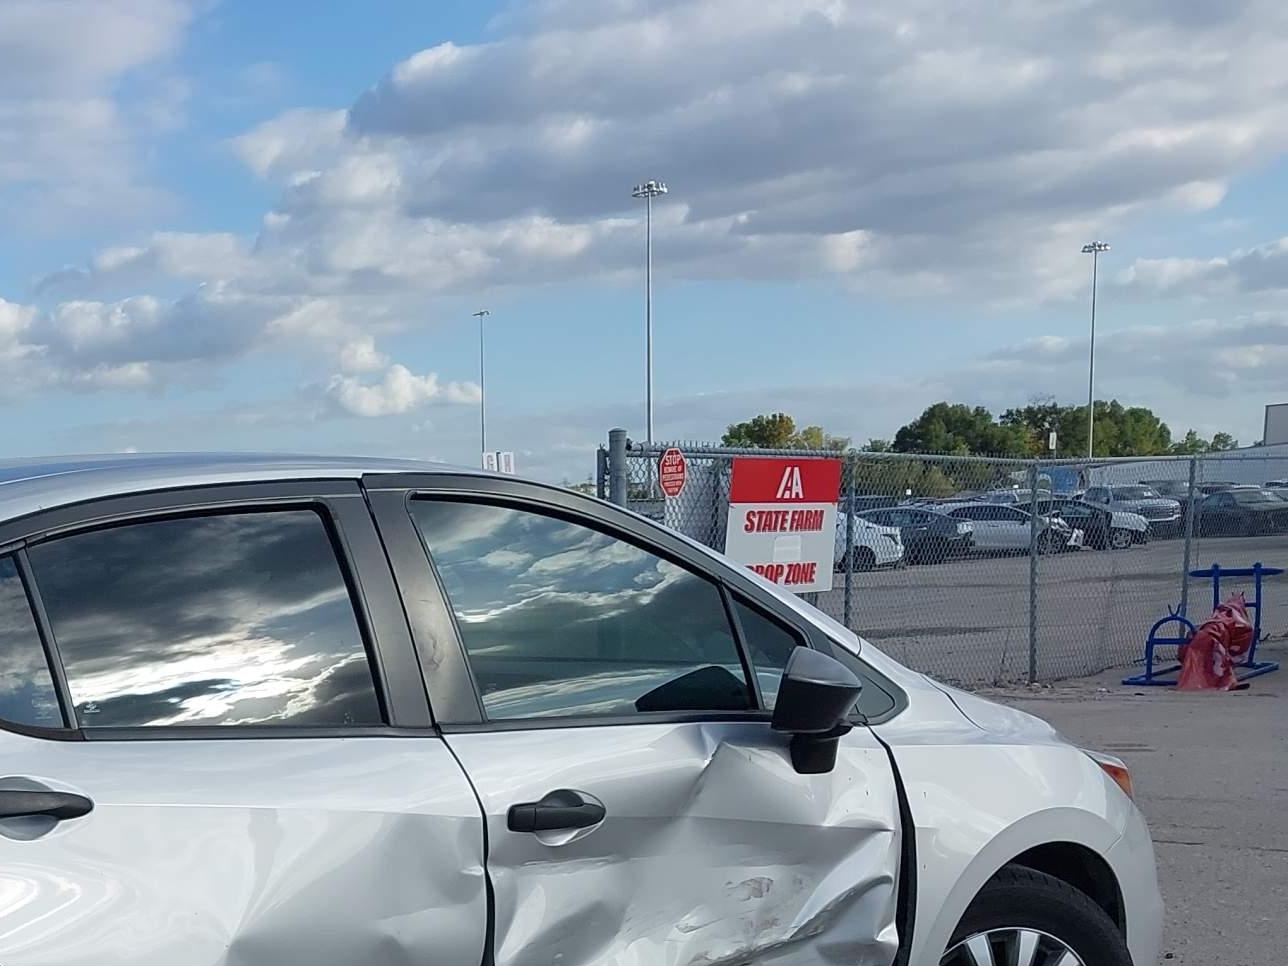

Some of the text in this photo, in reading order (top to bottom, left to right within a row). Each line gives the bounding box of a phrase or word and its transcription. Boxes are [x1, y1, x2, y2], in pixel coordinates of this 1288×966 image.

[665, 454, 681, 466] STOP
[744, 509, 824, 533] STATE FARM
[784, 562, 817, 585] ZONE
